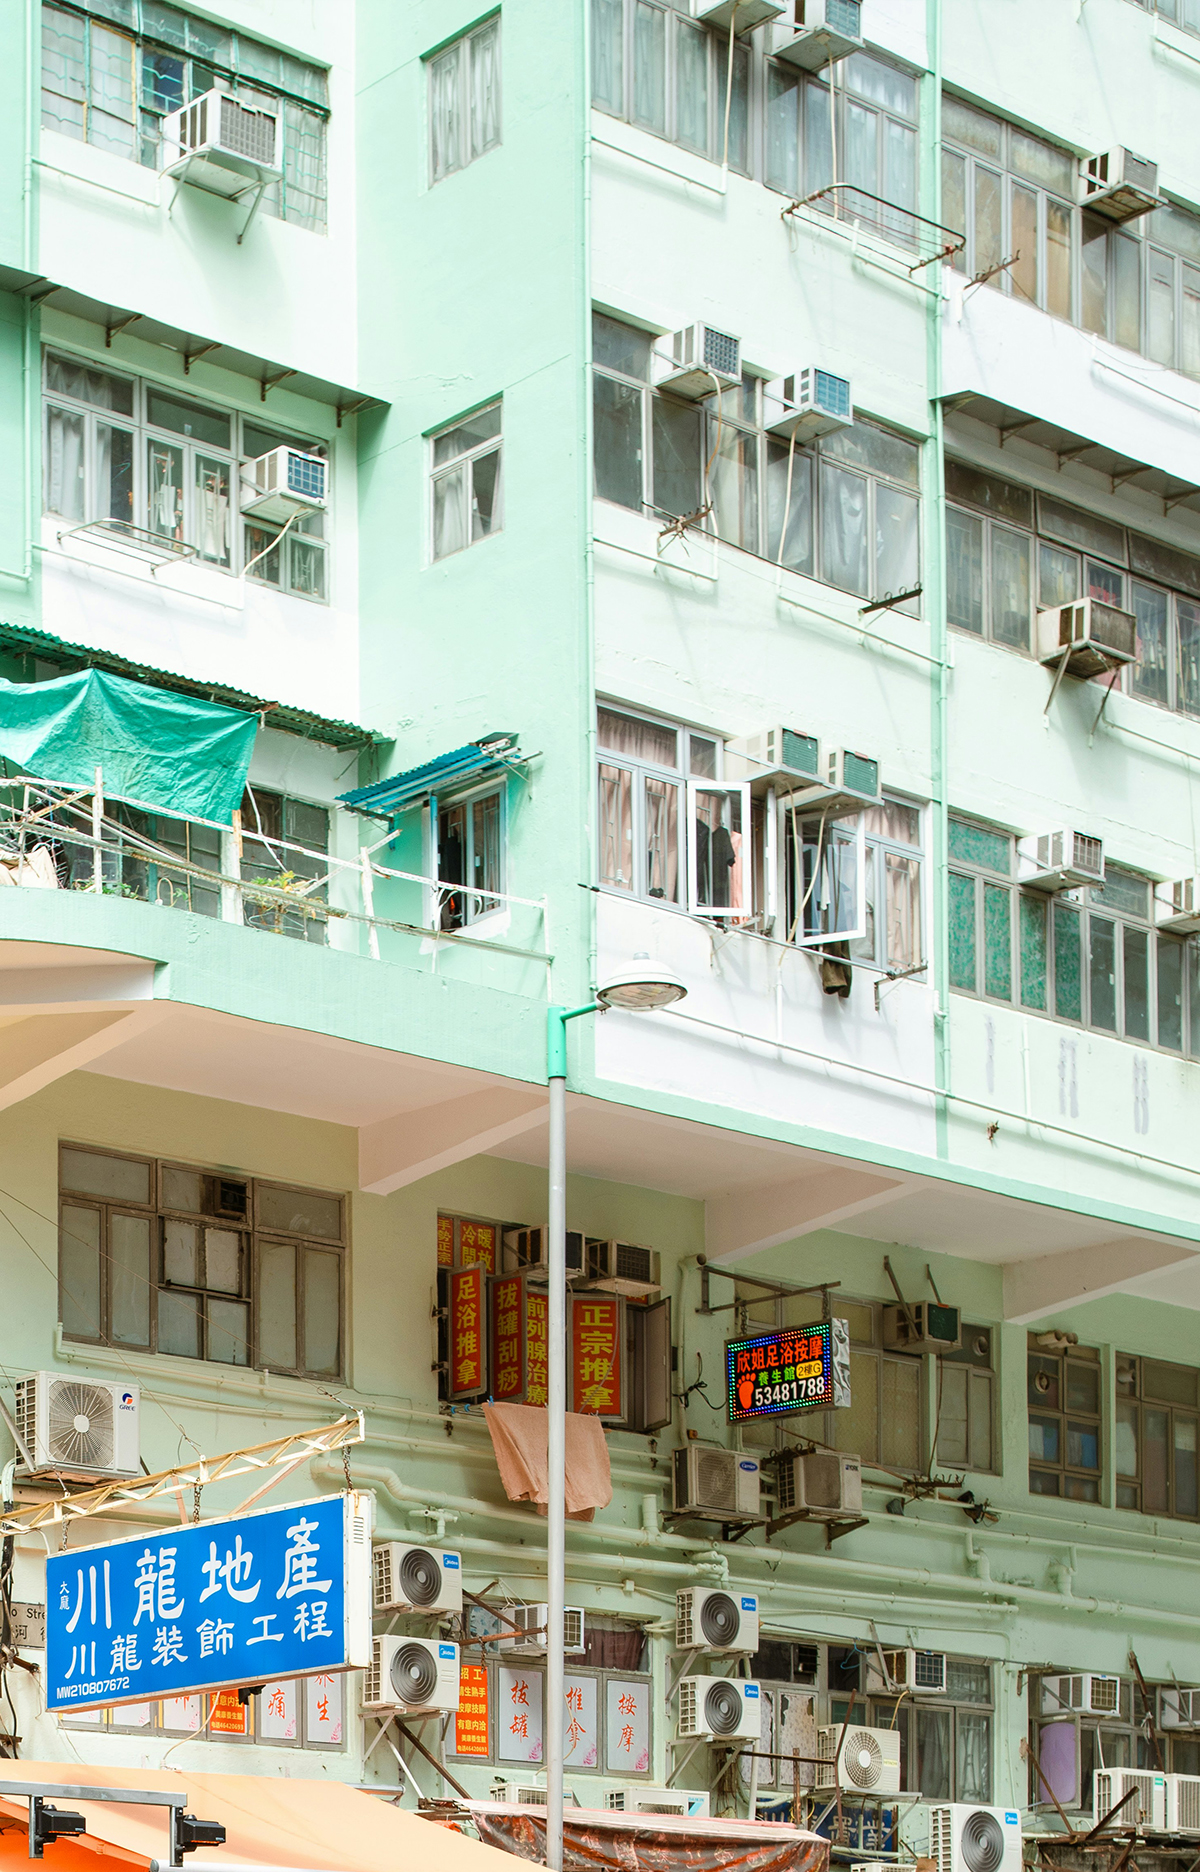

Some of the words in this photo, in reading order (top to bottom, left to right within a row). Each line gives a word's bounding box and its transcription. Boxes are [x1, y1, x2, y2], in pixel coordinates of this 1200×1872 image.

[462, 1224, 493, 1250] 冷暖
[455, 1275, 477, 1385] 足浴推拿
[497, 1282, 519, 1393] 拔罐刮痧
[527, 1296, 548, 1406] 前列腺治療
[579, 1304, 615, 1409] 正宗推拿
[737, 1335, 823, 1374] 欣姐足浴按摩
[755, 1376, 825, 1407] 53481788
[758, 1365, 796, 1386] 養生館
[65, 1517, 333, 1634] 川龍地產
[64, 1601, 334, 1680] 川龍裝飾工程
[56, 1677, 130, 1700] MW210807672
[267, 1687, 286, 1720] 痛
[509, 1679, 530, 1743] 拔罐
[566, 1686, 587, 1748] 推拿
[617, 1692, 638, 1753] 按摩
